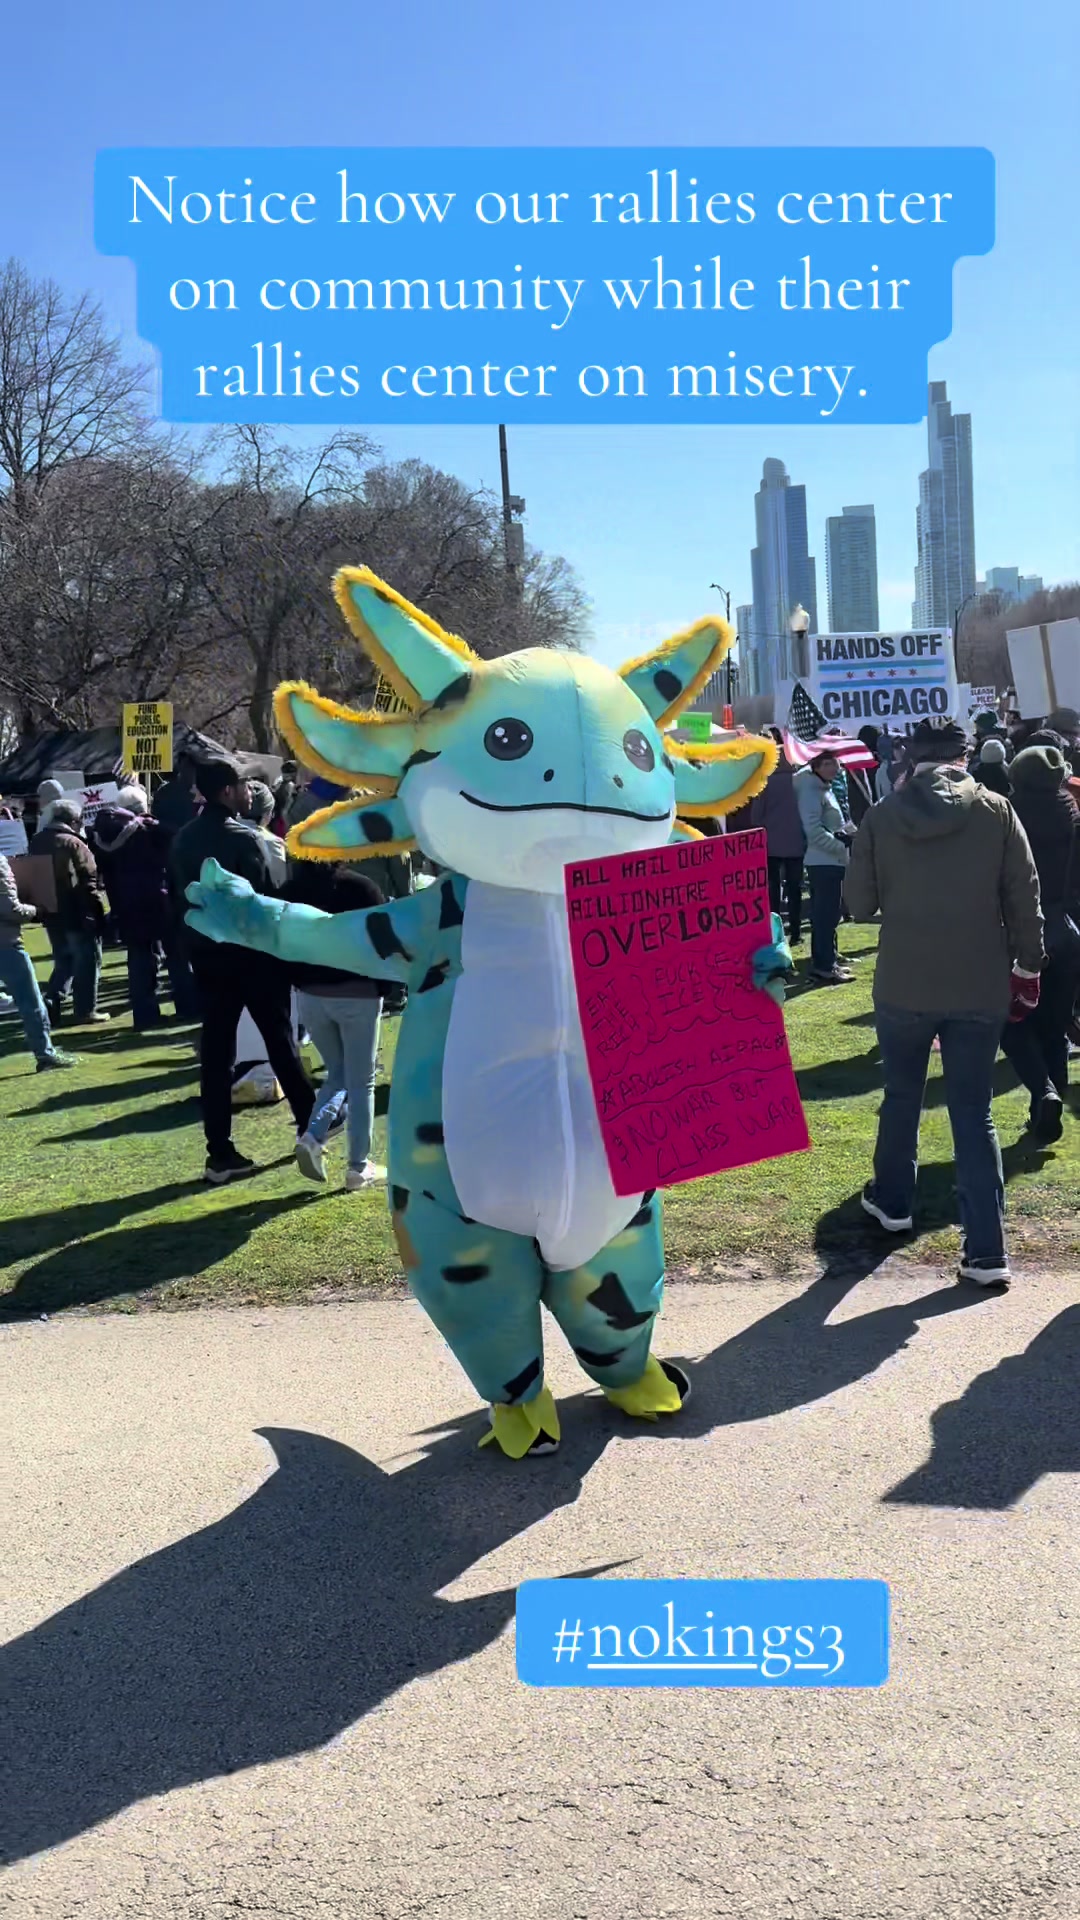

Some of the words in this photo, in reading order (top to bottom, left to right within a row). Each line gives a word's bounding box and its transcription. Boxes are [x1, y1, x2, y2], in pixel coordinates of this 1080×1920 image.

[816, 637, 896, 661] HANDS
[900, 633, 943, 657] OFF
[822, 686, 949, 720] CHICAGO
[126, 725, 168, 737] EDUCATION
[134, 714, 161, 726] PUBLIC
[136, 737, 158, 754] NOT
[131, 754, 162, 771] WAR!
[572, 865, 611, 888] ALL
[621, 855, 671, 879] HAIL
[677, 843, 714, 869] OUR
[724, 831, 764, 859] NAZI
[722, 867, 767, 897] PEDO
[581, 896, 766, 968] OVERLORDS
[655, 961, 702, 986] FUCK
[584, 977, 617, 1018] EAT
[626, 1109, 668, 1157] NO
[667, 1089, 720, 1129] WAR
[728, 1077, 769, 1103] BUT
[655, 1121, 730, 1179] CLASS
[737, 1096, 800, 1137] WAR
